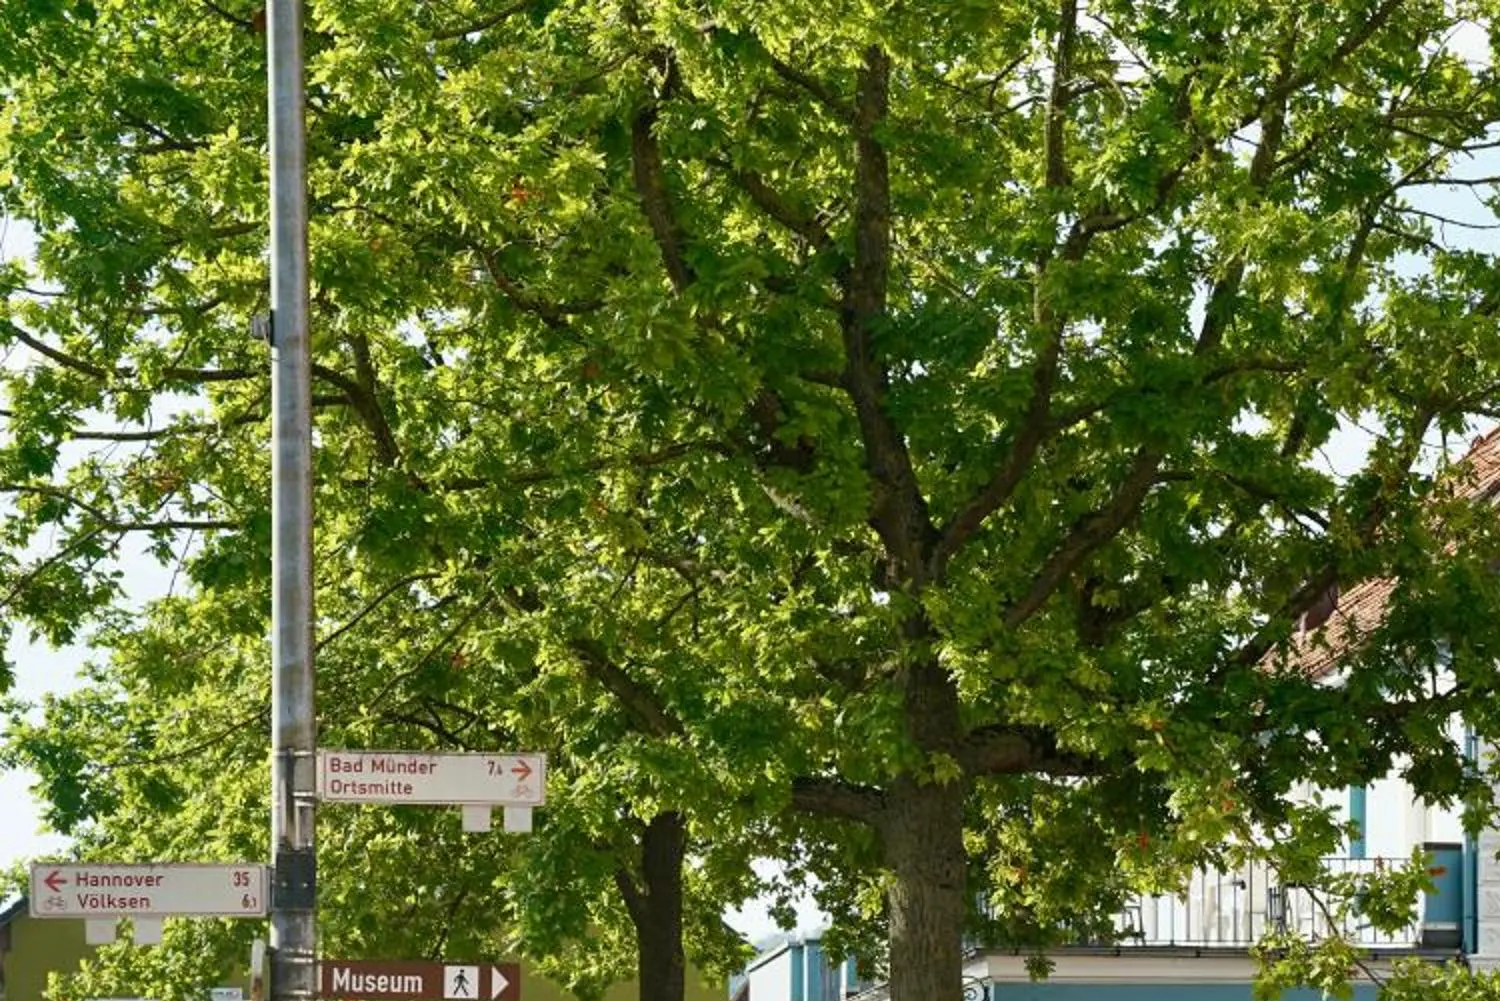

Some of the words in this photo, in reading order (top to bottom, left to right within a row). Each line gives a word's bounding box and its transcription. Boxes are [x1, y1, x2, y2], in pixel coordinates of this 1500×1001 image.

[329, 757, 363, 774] Bad
[371, 757, 438, 774] Münder
[330, 779, 413, 796] Ortsmitte
[76, 871, 164, 888] Hannover
[233, 871, 250, 887] 35
[77, 893, 150, 909] Völksen
[332, 967, 423, 993] Museum
